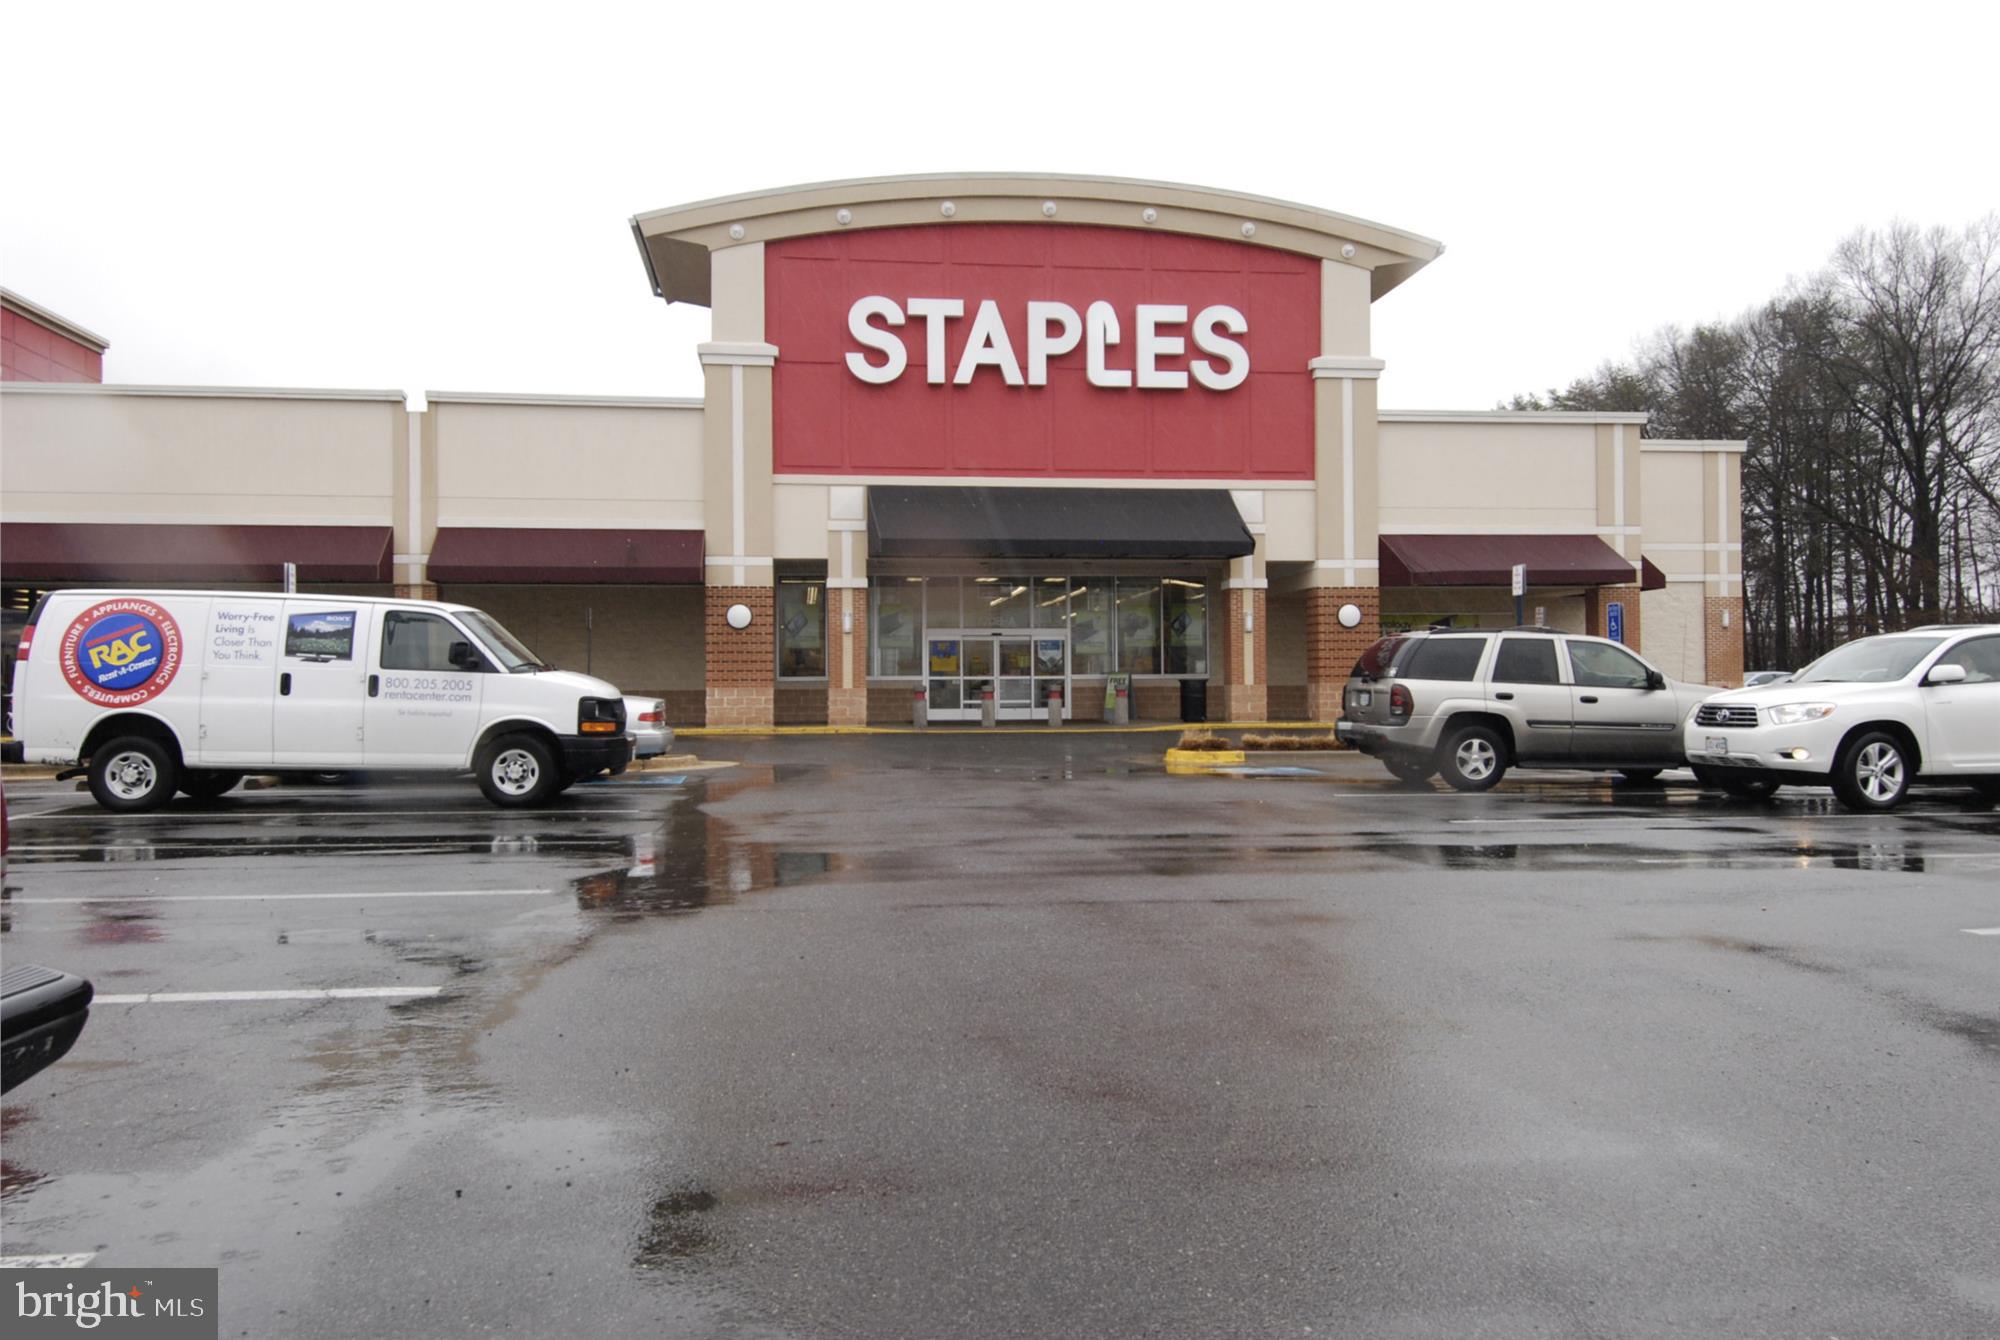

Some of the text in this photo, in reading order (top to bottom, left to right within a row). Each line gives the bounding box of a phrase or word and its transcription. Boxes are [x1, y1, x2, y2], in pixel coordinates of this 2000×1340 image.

[845, 295, 1250, 391] STAPLES
[92, 601, 158, 618] APPLIANCES
[217, 611, 275, 623] Worry-Free
[215, 624, 244, 635] Living
[64, 622, 85, 679] FURNITURE
[88, 630, 152, 669] RAC
[213, 637, 272, 647] Closer Than
[156, 620, 179, 685] ELECTRONICS
[213, 650, 231, 660] You
[82, 684, 148, 704] COMPUTERS
[384, 691, 472, 702] rentacenter.com
